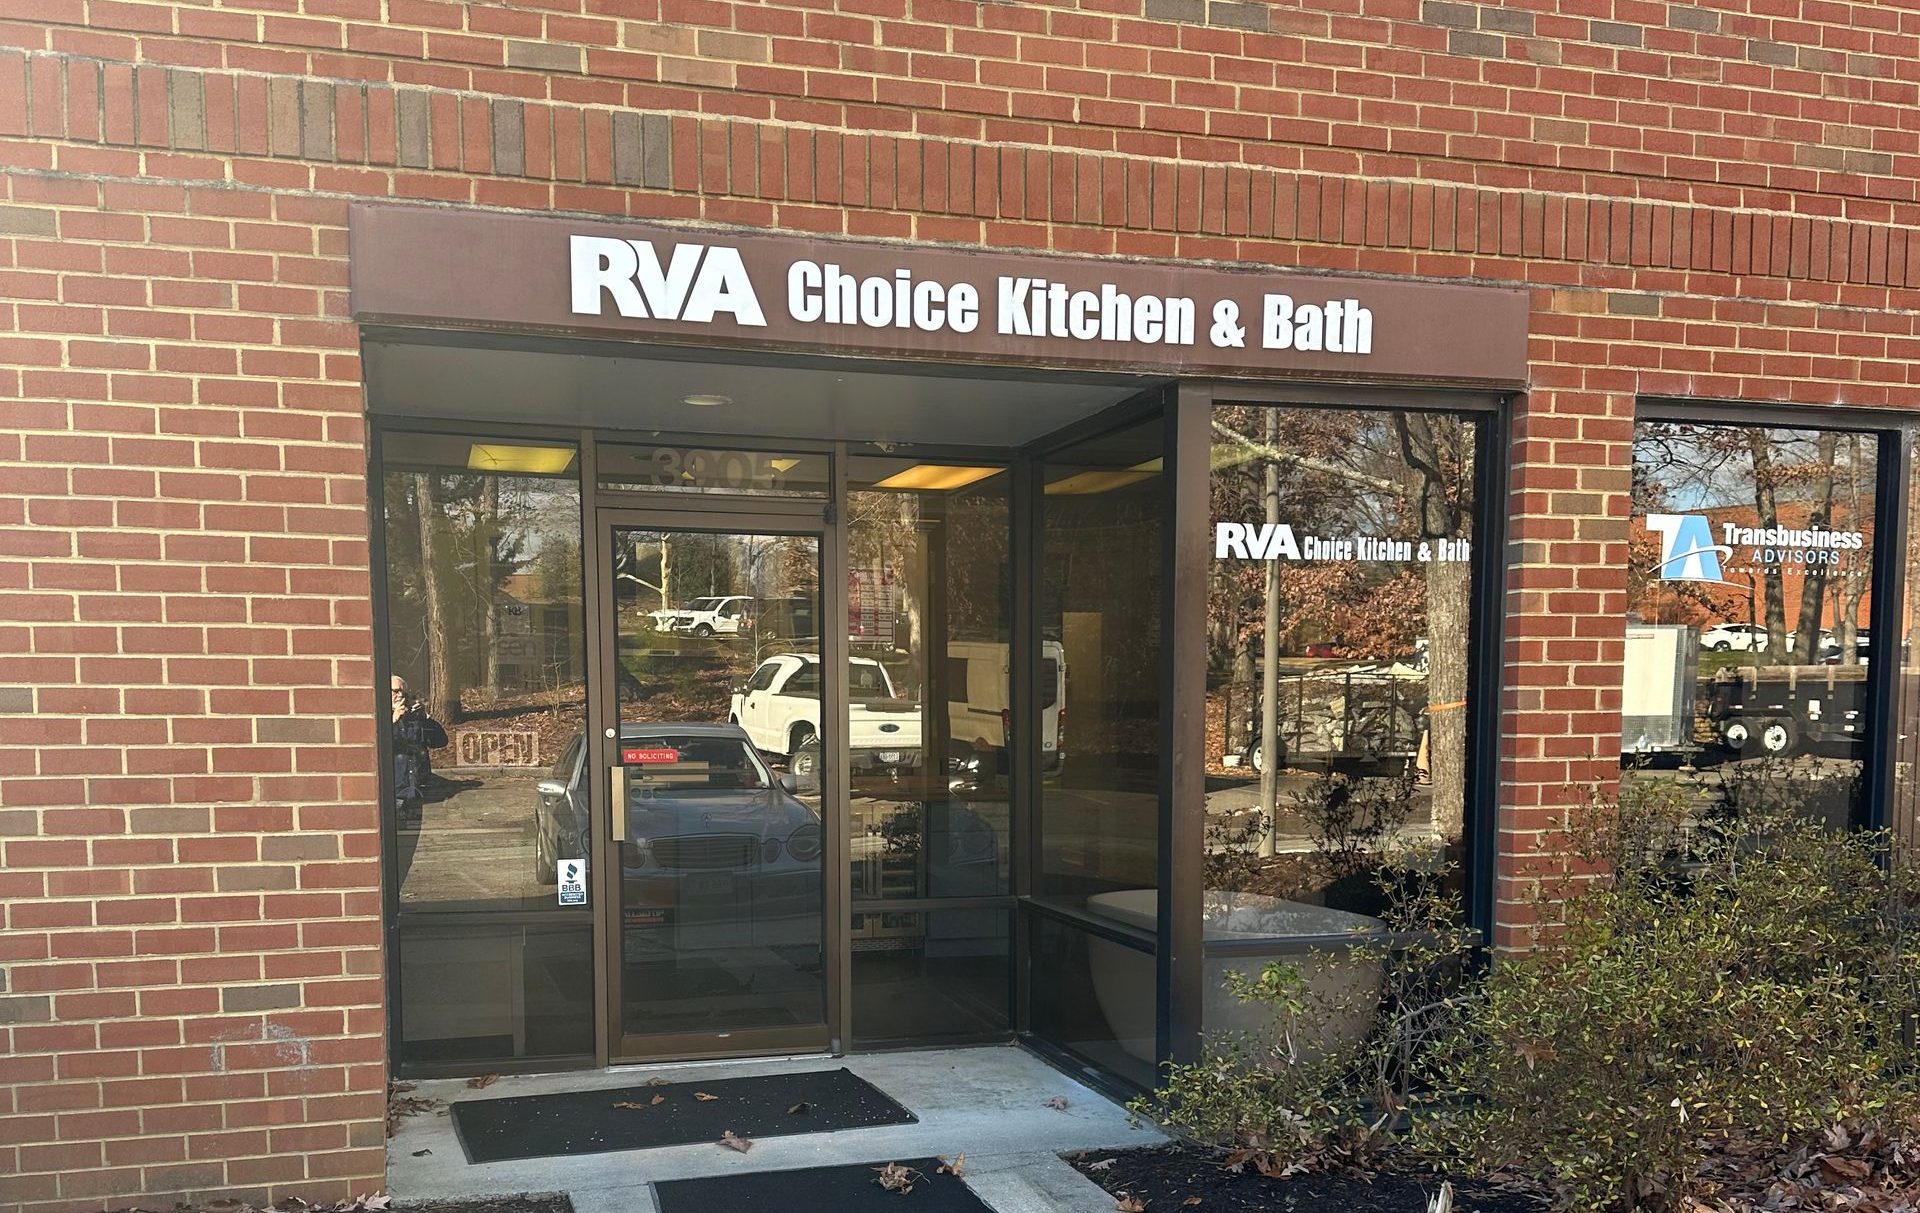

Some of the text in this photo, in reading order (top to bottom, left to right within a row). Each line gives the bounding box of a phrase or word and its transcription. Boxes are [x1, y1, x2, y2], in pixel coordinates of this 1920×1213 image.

[570, 235, 1373, 354] RVA Choice Kitchen & Bath
[1215, 522, 1470, 562] RVA Choice Kitchen & Bath
[1723, 522, 1863, 549] Transbusiness
[1752, 549, 1840, 565] ADVISORS
[463, 732, 533, 765] OPEN
[627, 752, 637, 760] NO
[562, 884, 582, 892] BBB
